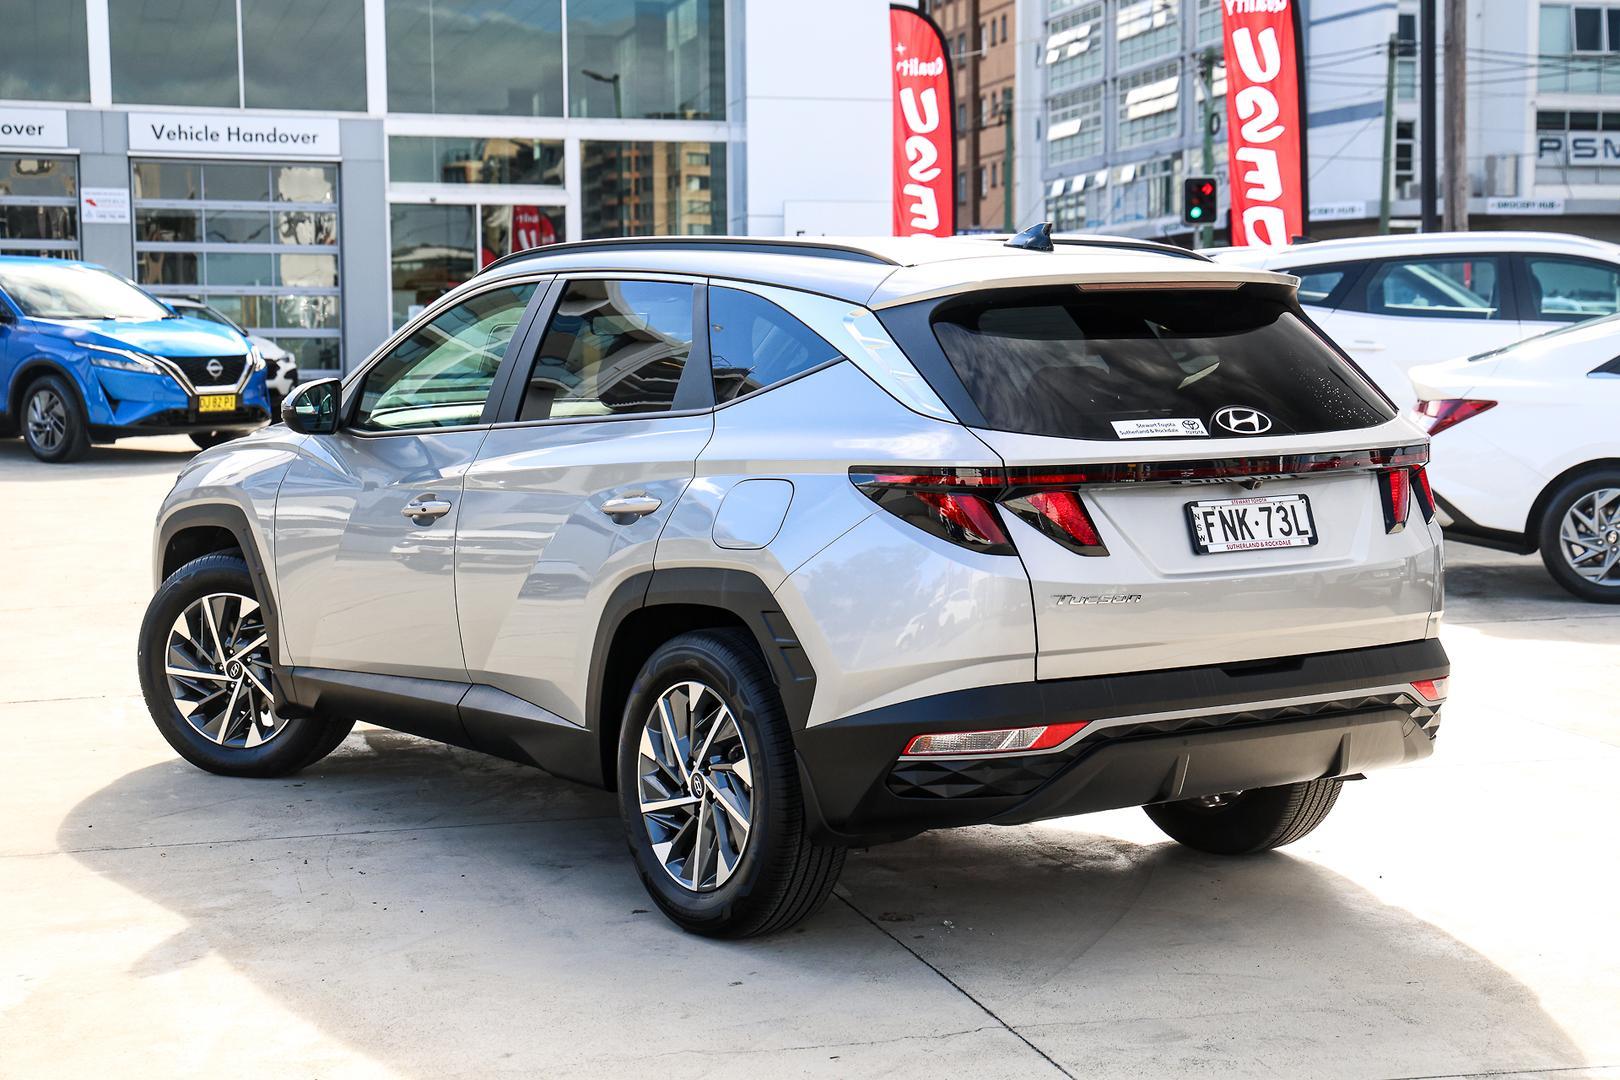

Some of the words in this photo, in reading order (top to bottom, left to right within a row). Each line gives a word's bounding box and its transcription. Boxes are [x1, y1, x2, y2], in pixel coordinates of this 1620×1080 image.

[1, 124, 45, 136] over
[151, 123, 219, 142] Vehicle
[227, 126, 319, 144] Handover
[1226, 541, 1260, 551] SUTHERLAND
[1264, 539, 1292, 547] ROCKDALE
